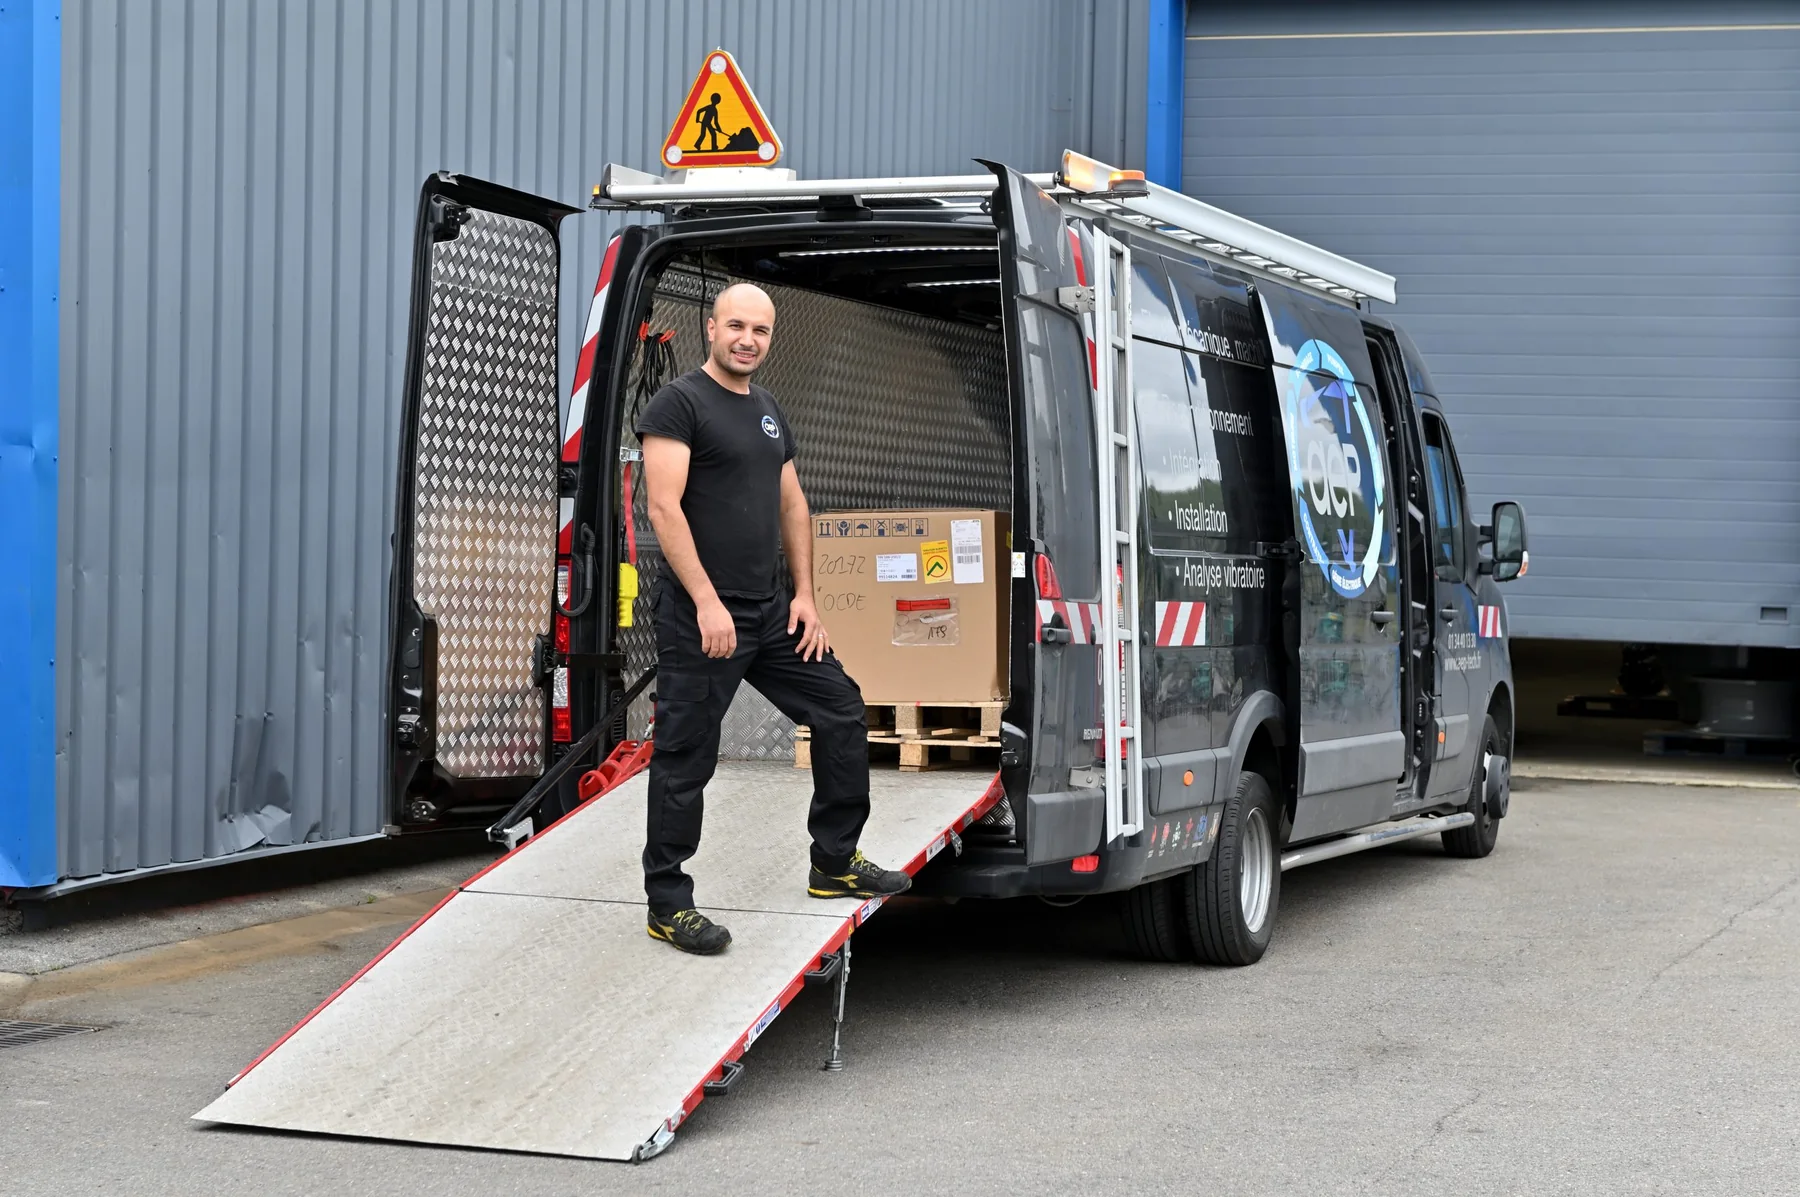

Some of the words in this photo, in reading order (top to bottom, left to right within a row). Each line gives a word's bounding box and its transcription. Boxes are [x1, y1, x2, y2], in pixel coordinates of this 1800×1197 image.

[1174, 499, 1229, 533] Installation
[1183, 557, 1222, 595] Analyse
[1223, 558, 1265, 589] vibratoire
